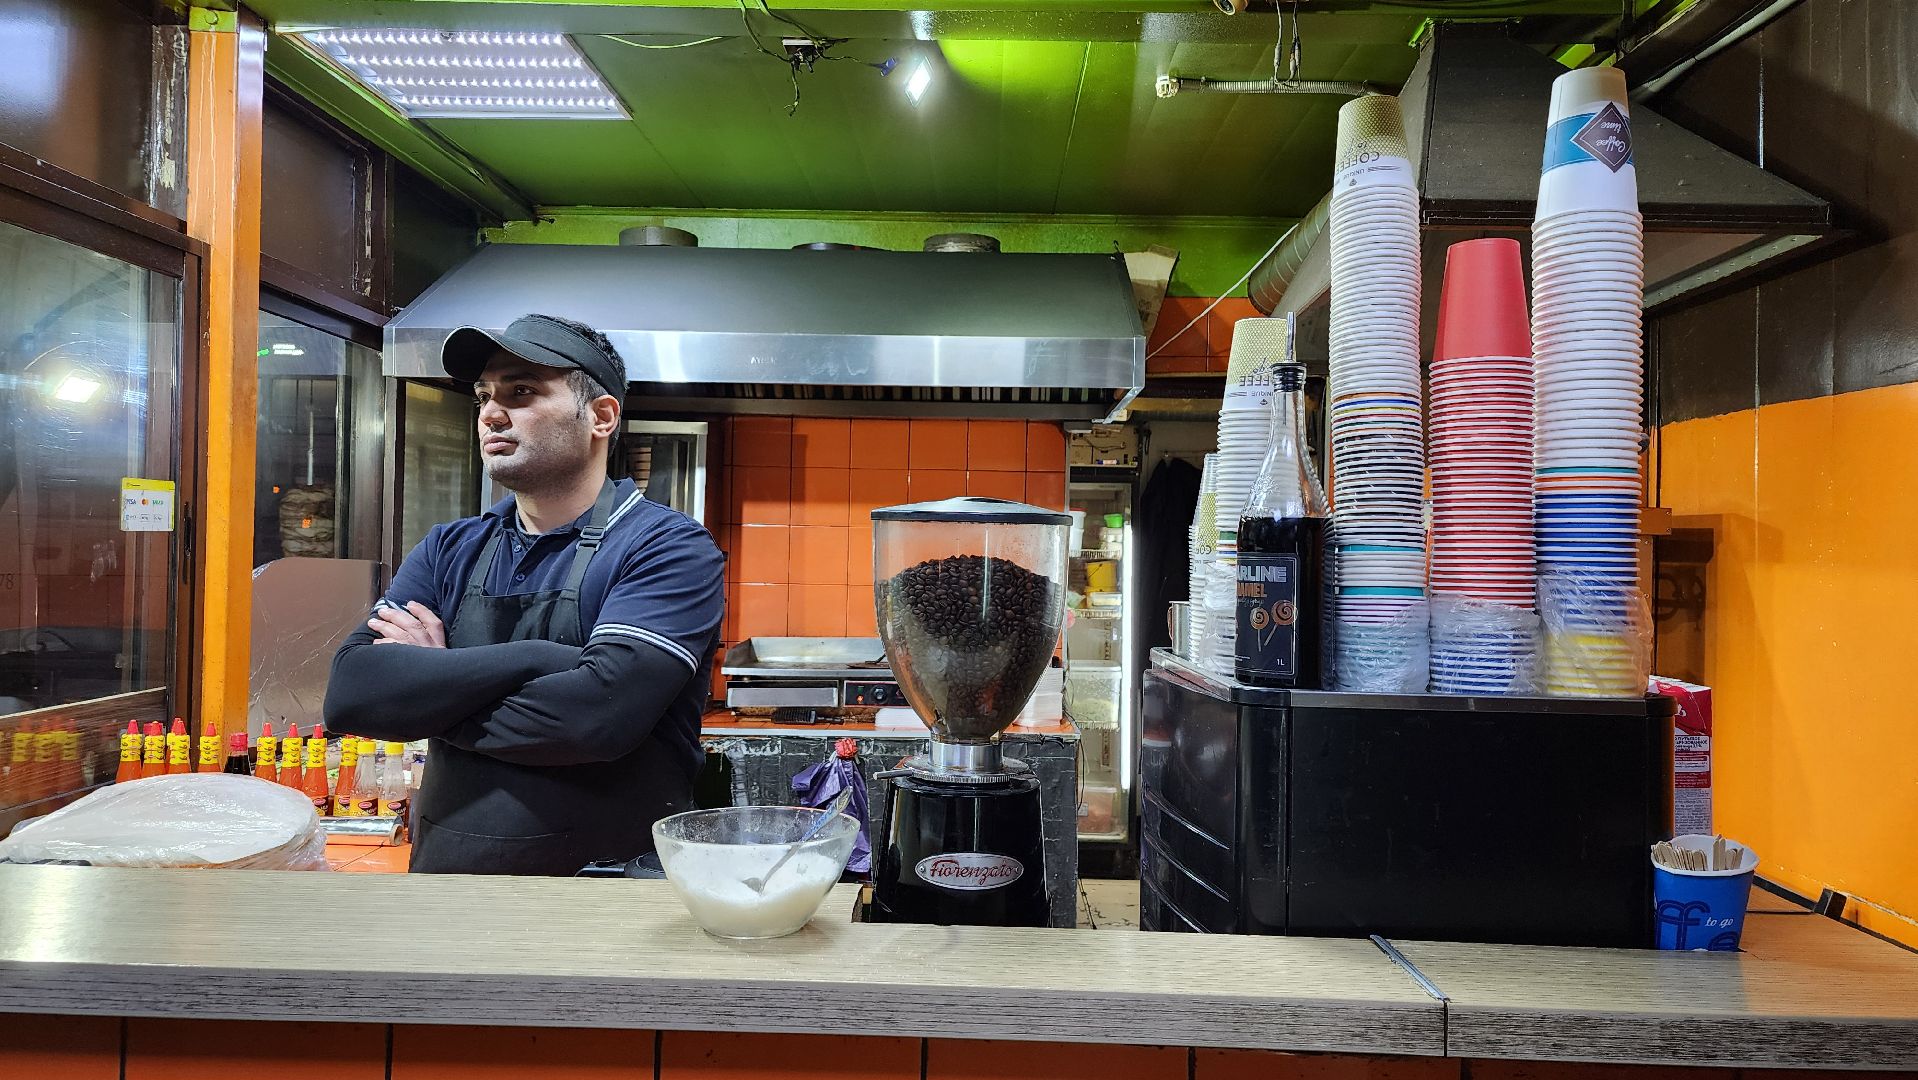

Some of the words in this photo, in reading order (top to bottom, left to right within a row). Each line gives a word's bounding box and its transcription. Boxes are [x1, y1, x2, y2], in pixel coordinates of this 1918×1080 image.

[1600, 121, 1622, 134] time
[1595, 135, 1626, 153] Coffee
[930, 859, 1014, 885] Fiorenzato
[1704, 916, 1717, 927] to
[1719, 917, 1734, 929] go
